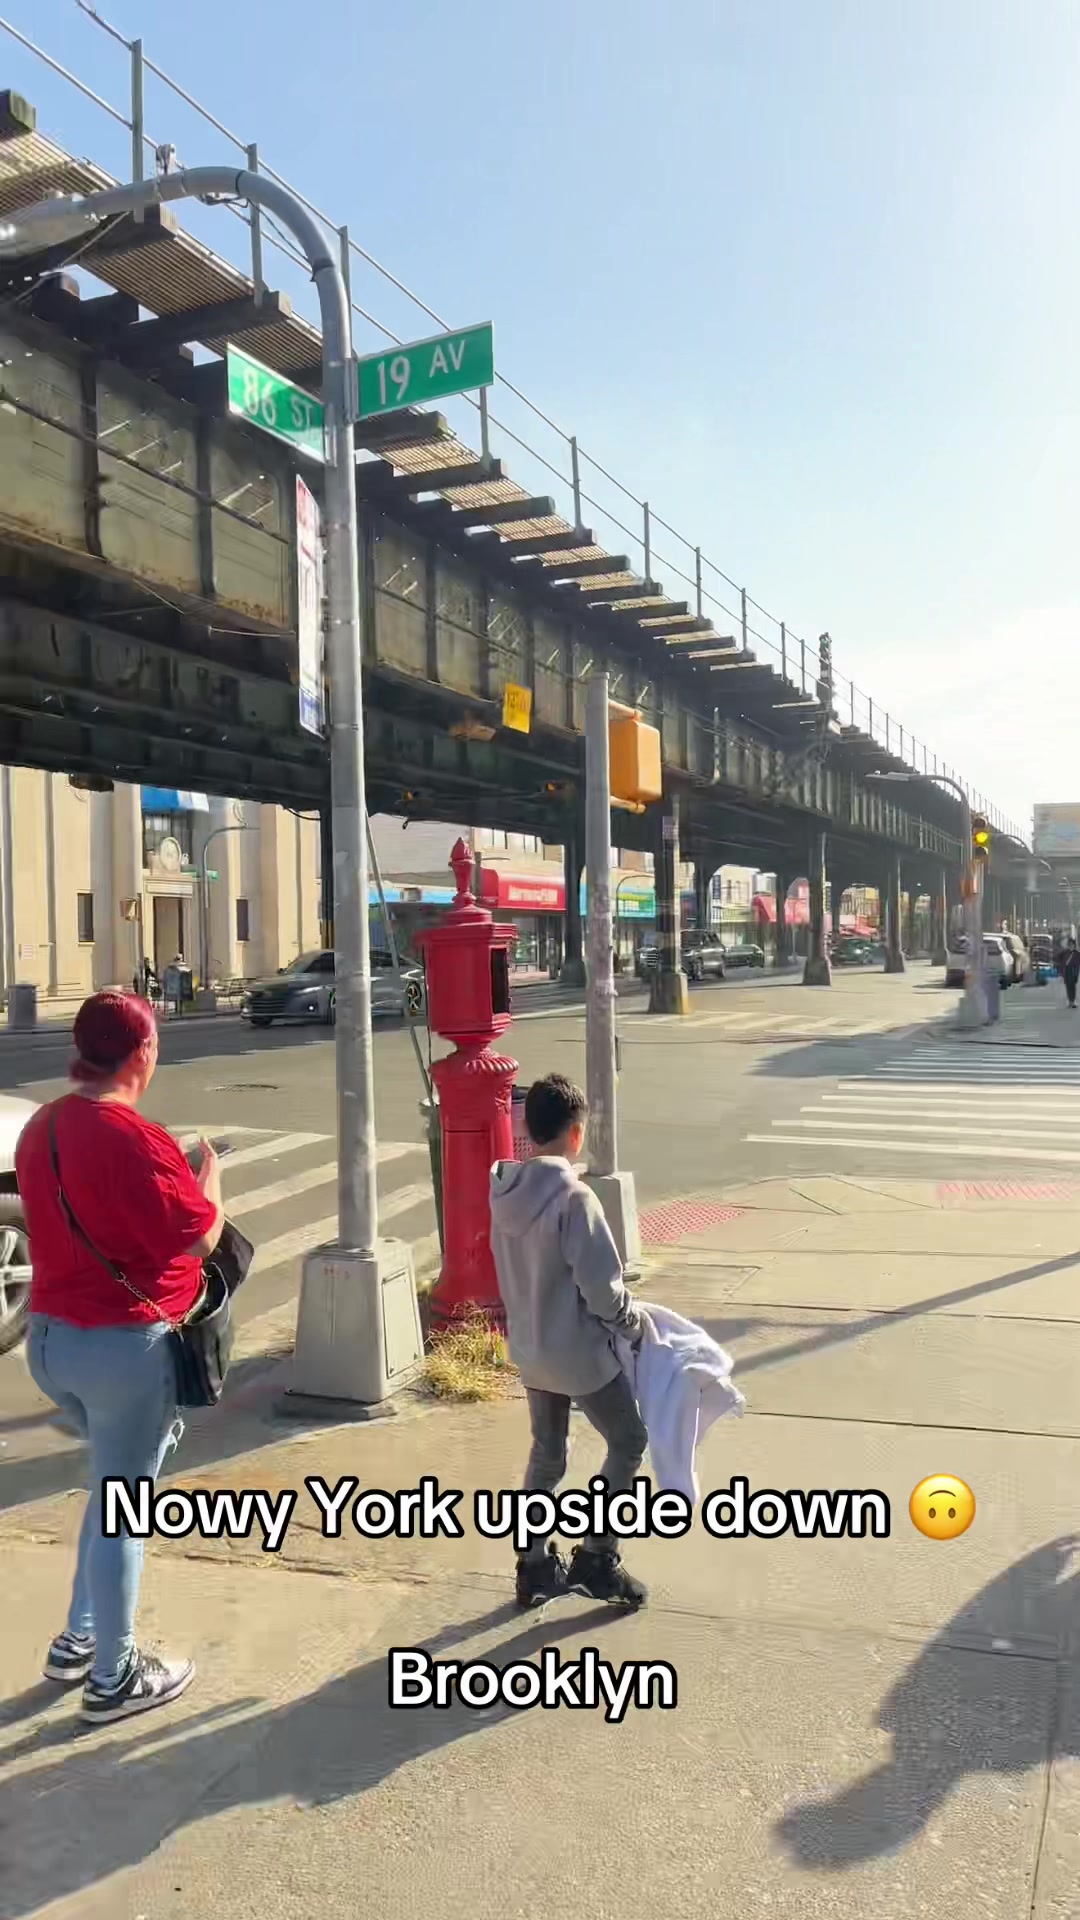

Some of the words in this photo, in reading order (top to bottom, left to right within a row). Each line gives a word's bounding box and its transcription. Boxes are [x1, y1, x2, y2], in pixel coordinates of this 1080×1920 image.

[243, 366, 276, 426] 86
[290, 394, 313, 432] ST
[378, 355, 411, 405] 19
[429, 339, 466, 378] AV
